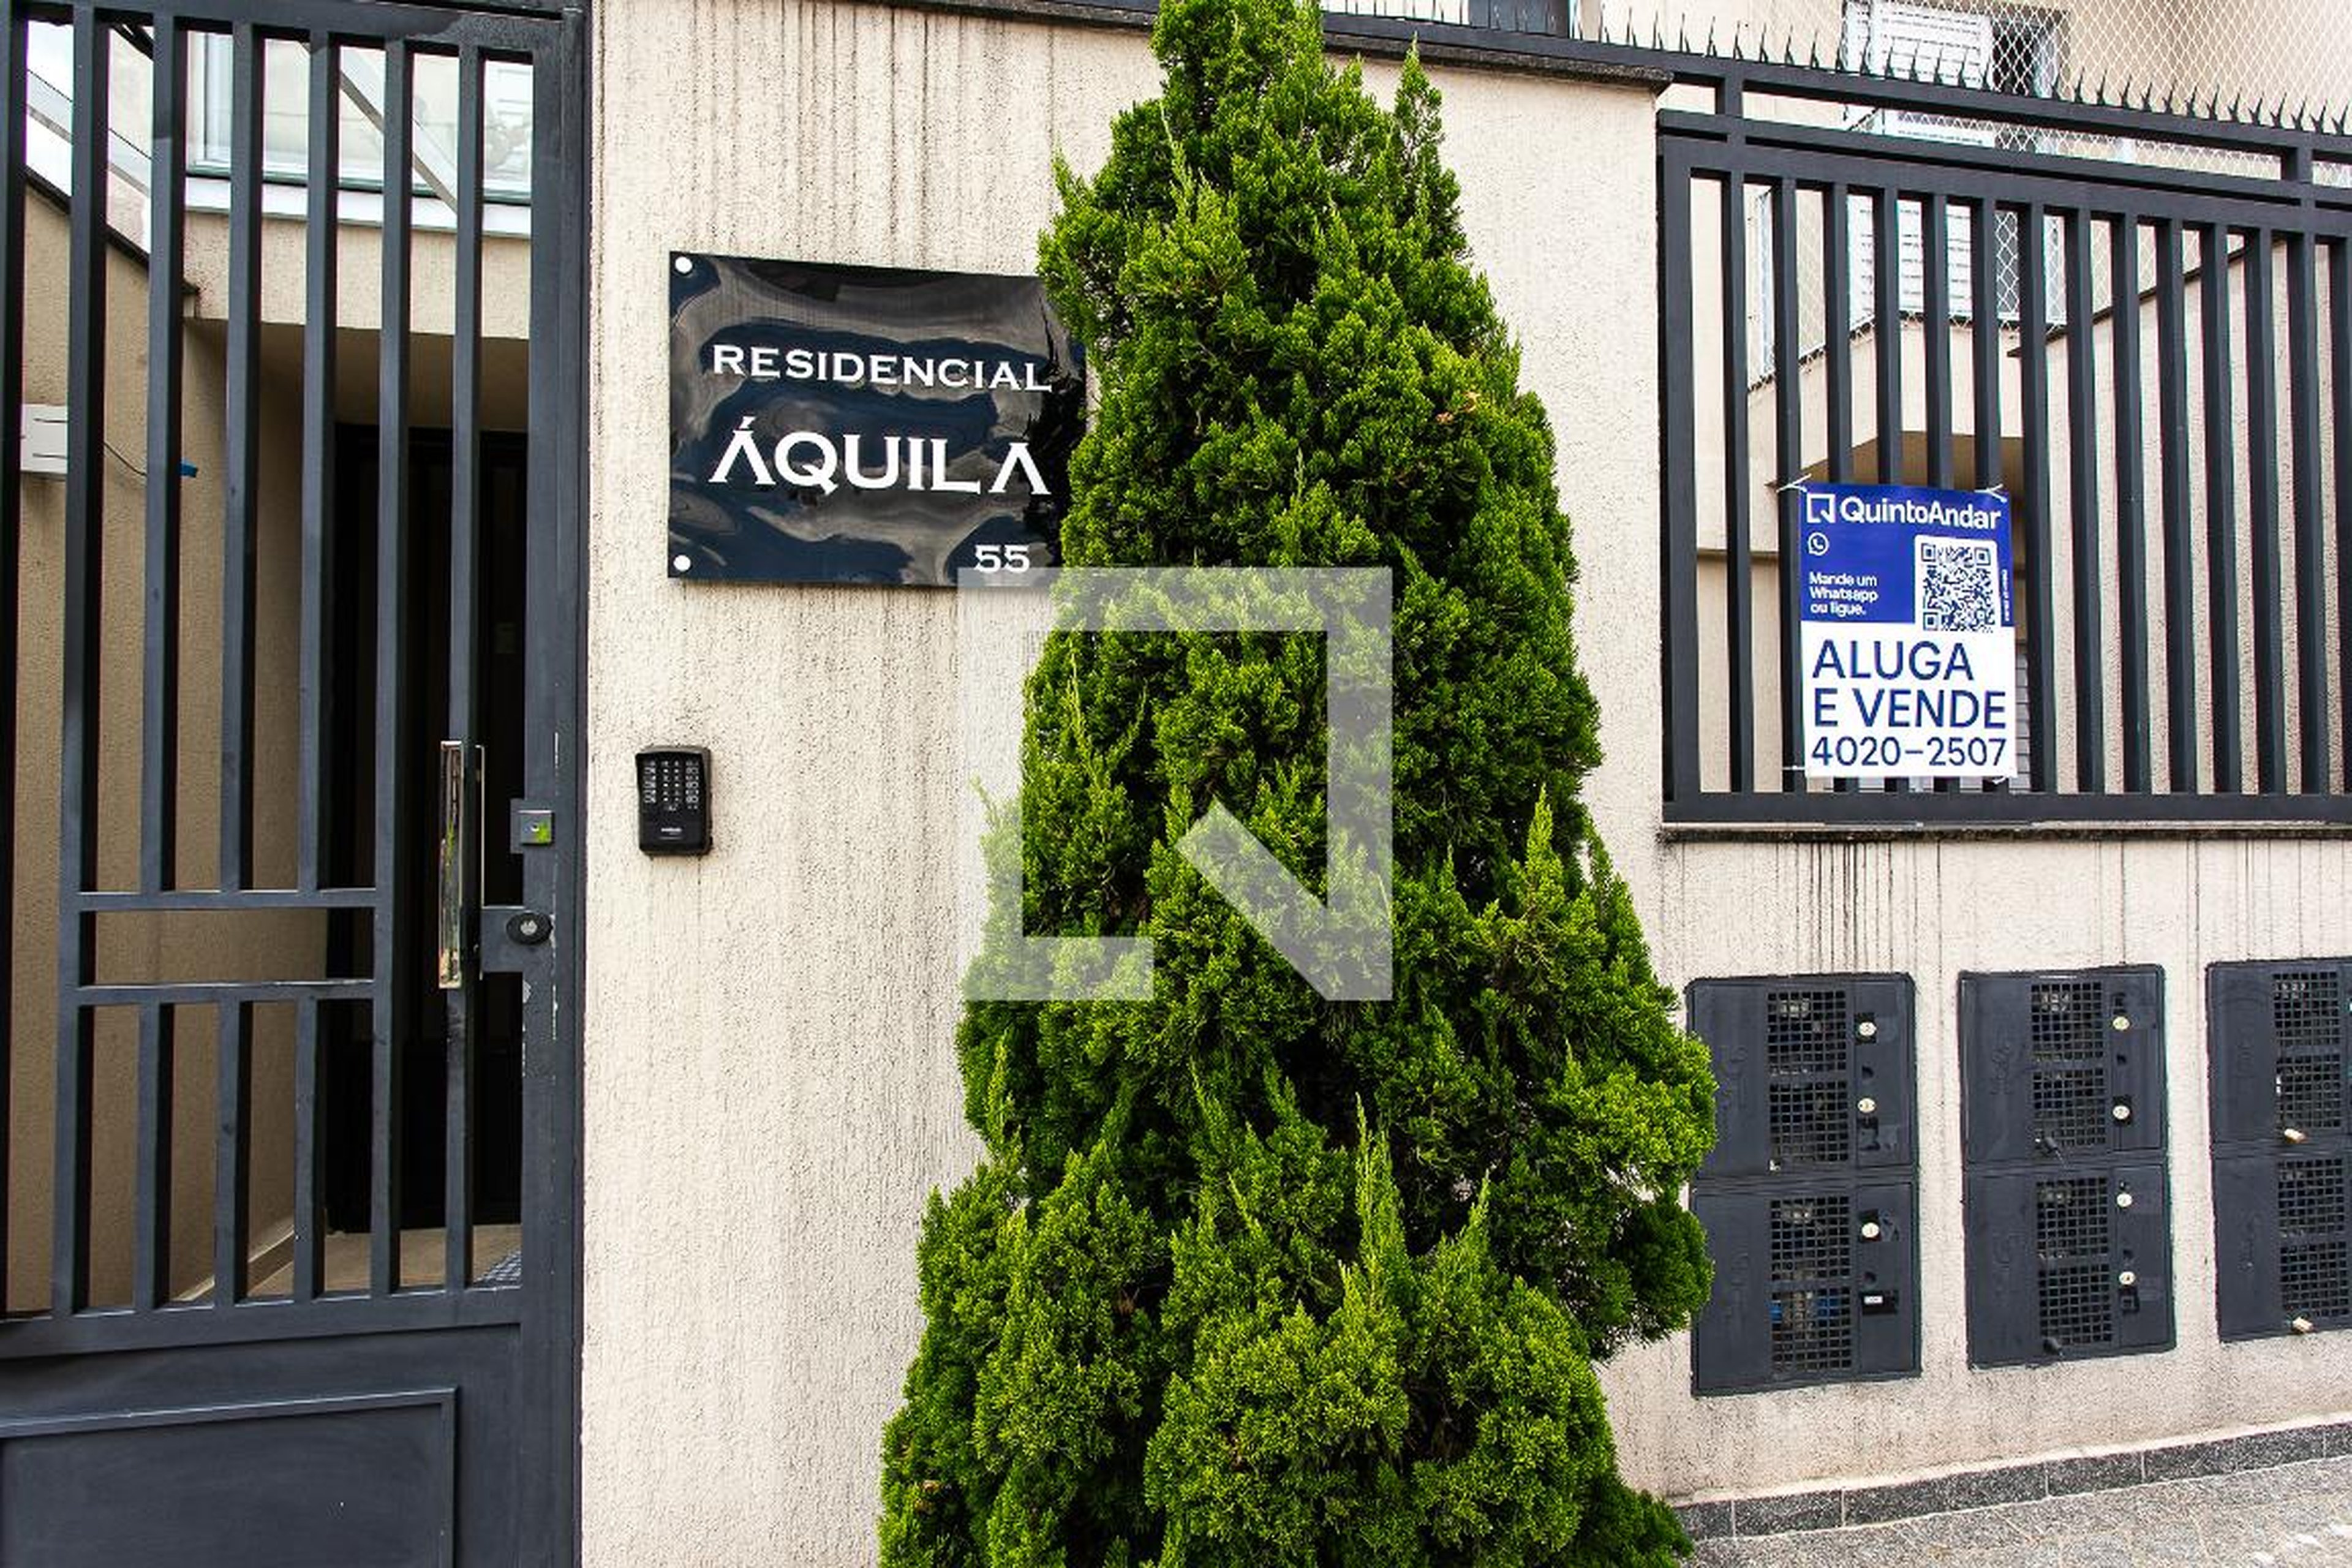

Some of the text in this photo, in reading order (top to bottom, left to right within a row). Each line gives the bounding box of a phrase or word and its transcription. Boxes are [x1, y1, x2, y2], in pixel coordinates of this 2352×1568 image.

[712, 344, 1053, 392] RESIDENCIAL
[707, 416, 1052, 496] ÁQUILA
[1839, 496, 2002, 530] QuintoAndar
[973, 544, 1031, 573] 55
[1809, 571, 1878, 587] Mande um
[1809, 586, 1879, 603] Whatsapp
[1810, 601, 1866, 617] ou ligue.
[1812, 639, 1974, 681] ALUGA
[1814, 687, 2007, 729] E VENDE
[1811, 736, 2007, 767] 4020-2507
